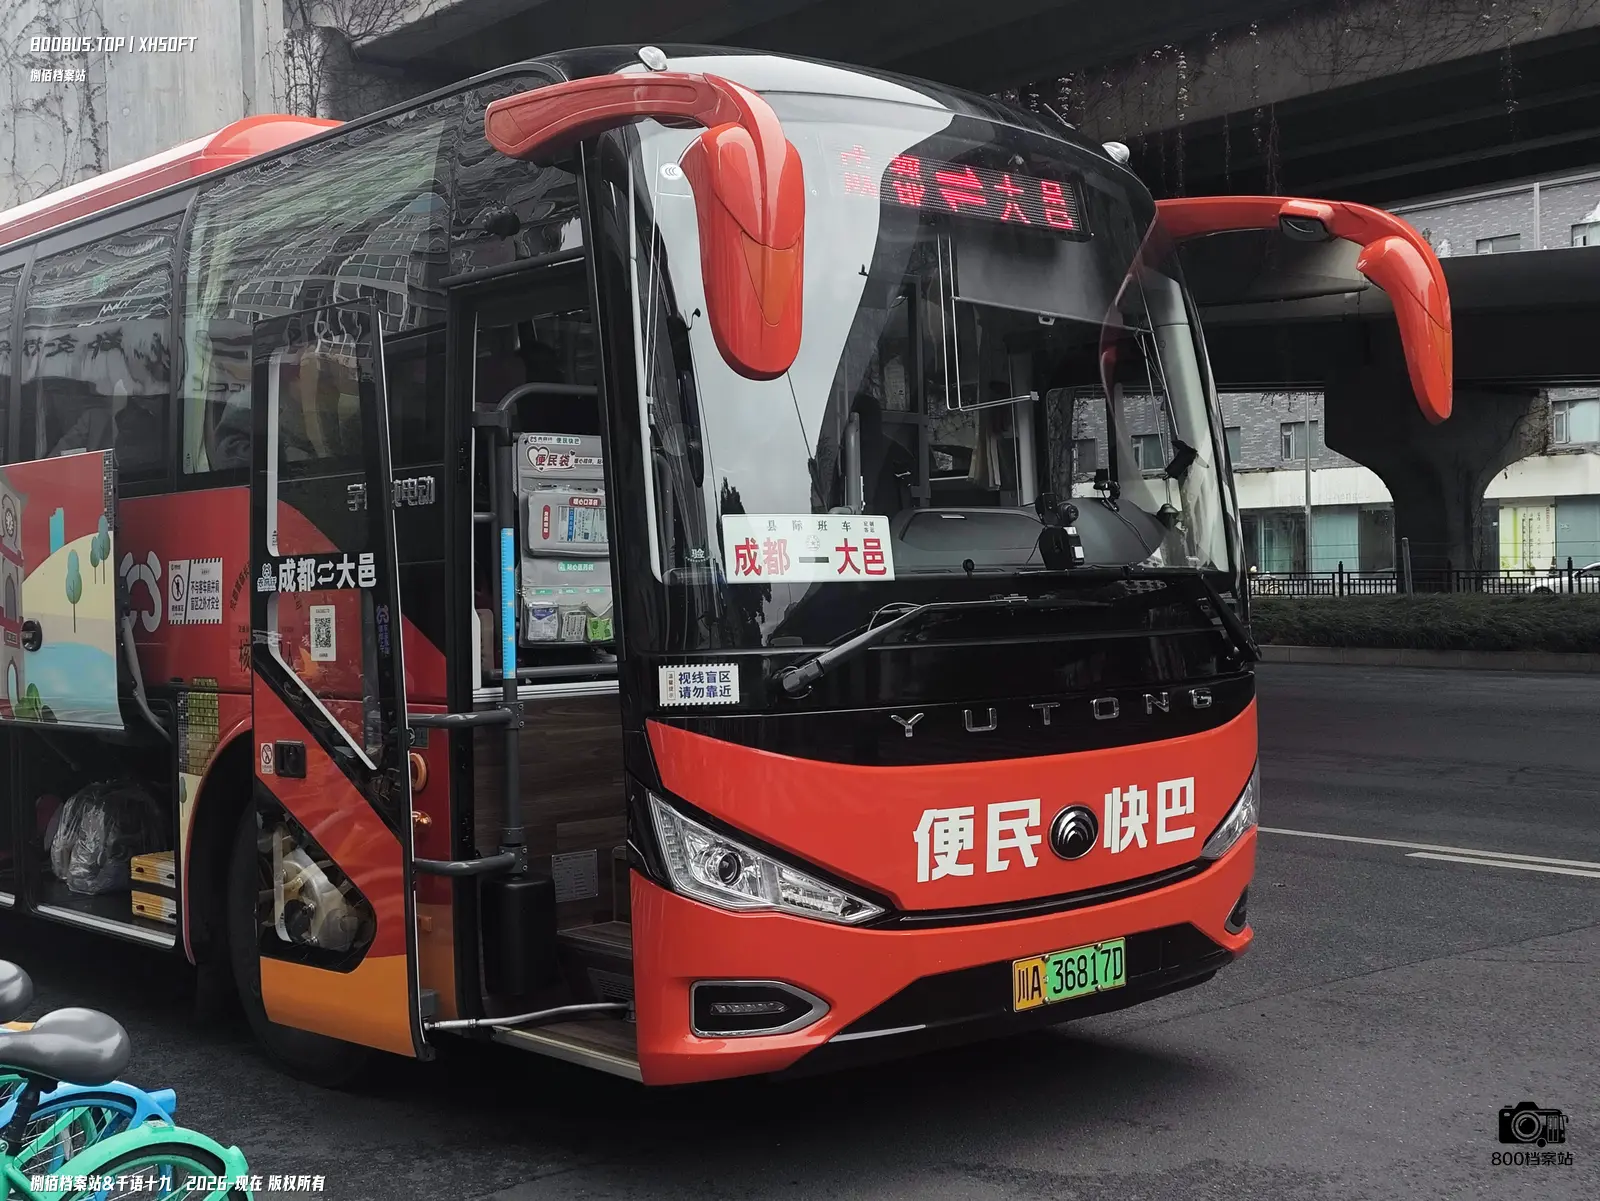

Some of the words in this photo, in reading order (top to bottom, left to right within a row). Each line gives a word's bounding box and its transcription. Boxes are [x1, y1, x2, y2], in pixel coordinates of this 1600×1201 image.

[535, 453, 570, 467] 便民袋
[767, 519, 852, 532] 县际班车
[278, 557, 316, 593] 成都
[336, 552, 377, 589] 大邑
[678, 671, 731, 685] 视线盲区
[678, 684, 732, 699] 请勿靠近
[890, 687, 1213, 737] YUTONG
[913, 797, 1043, 883] 便民
[1103, 776, 1197, 854] 快巴
